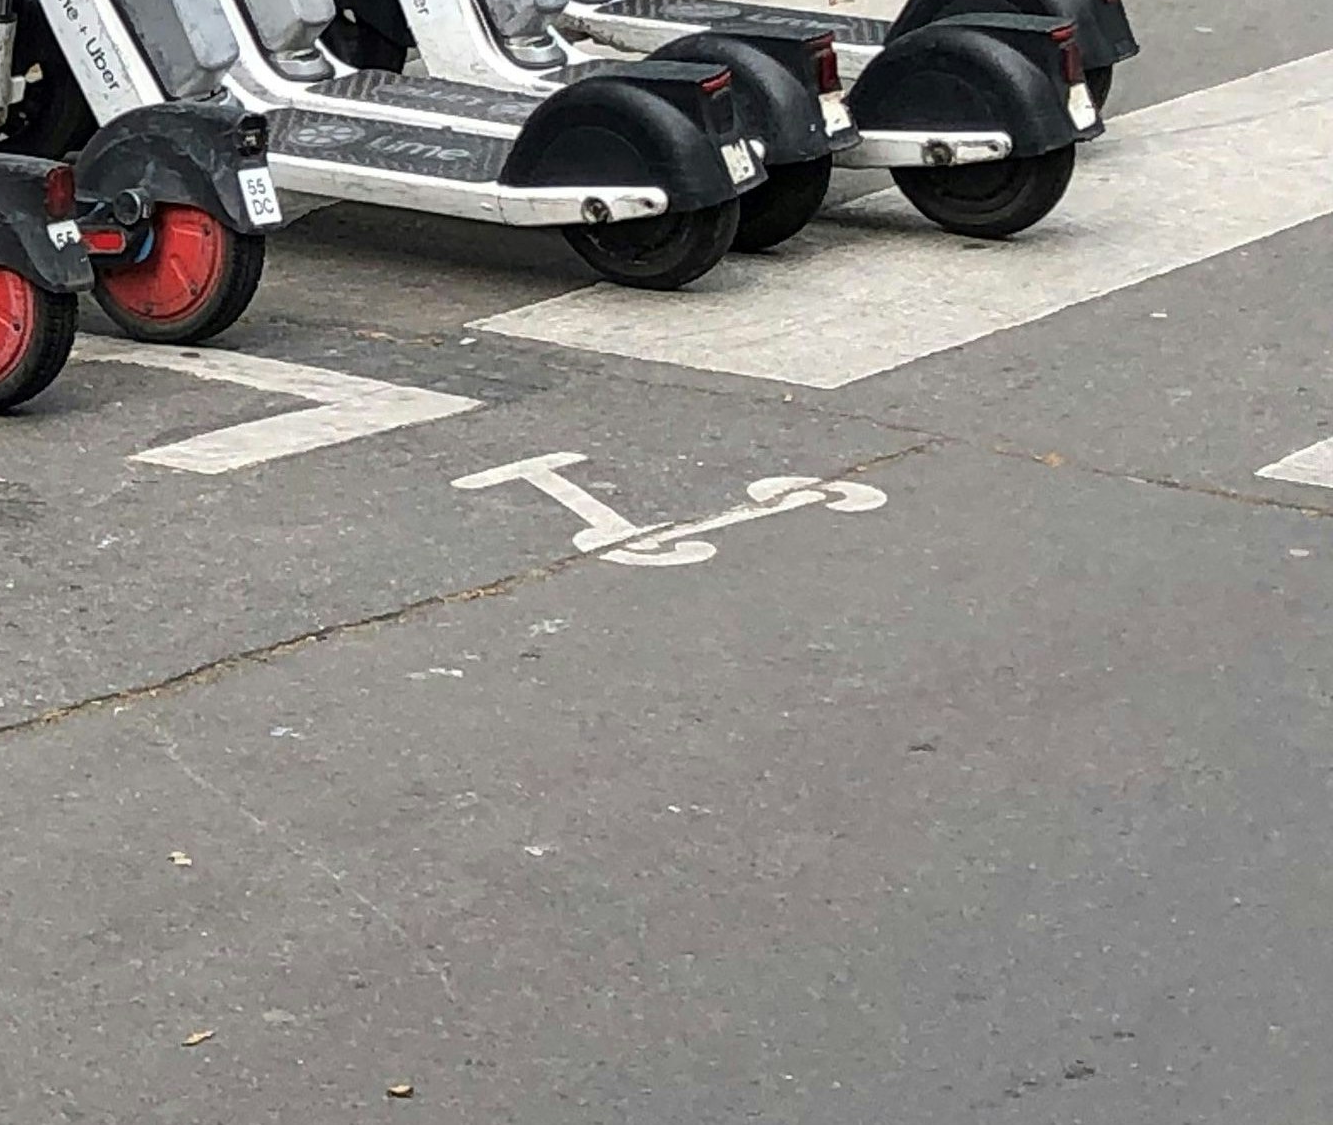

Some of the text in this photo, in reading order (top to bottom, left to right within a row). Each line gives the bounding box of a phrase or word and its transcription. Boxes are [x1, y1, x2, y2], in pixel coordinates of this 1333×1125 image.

[85, 37, 120, 89] Uber
[366, 135, 470, 161] Lime
[246, 178, 266, 195] 55
[252, 197, 274, 215] DC
